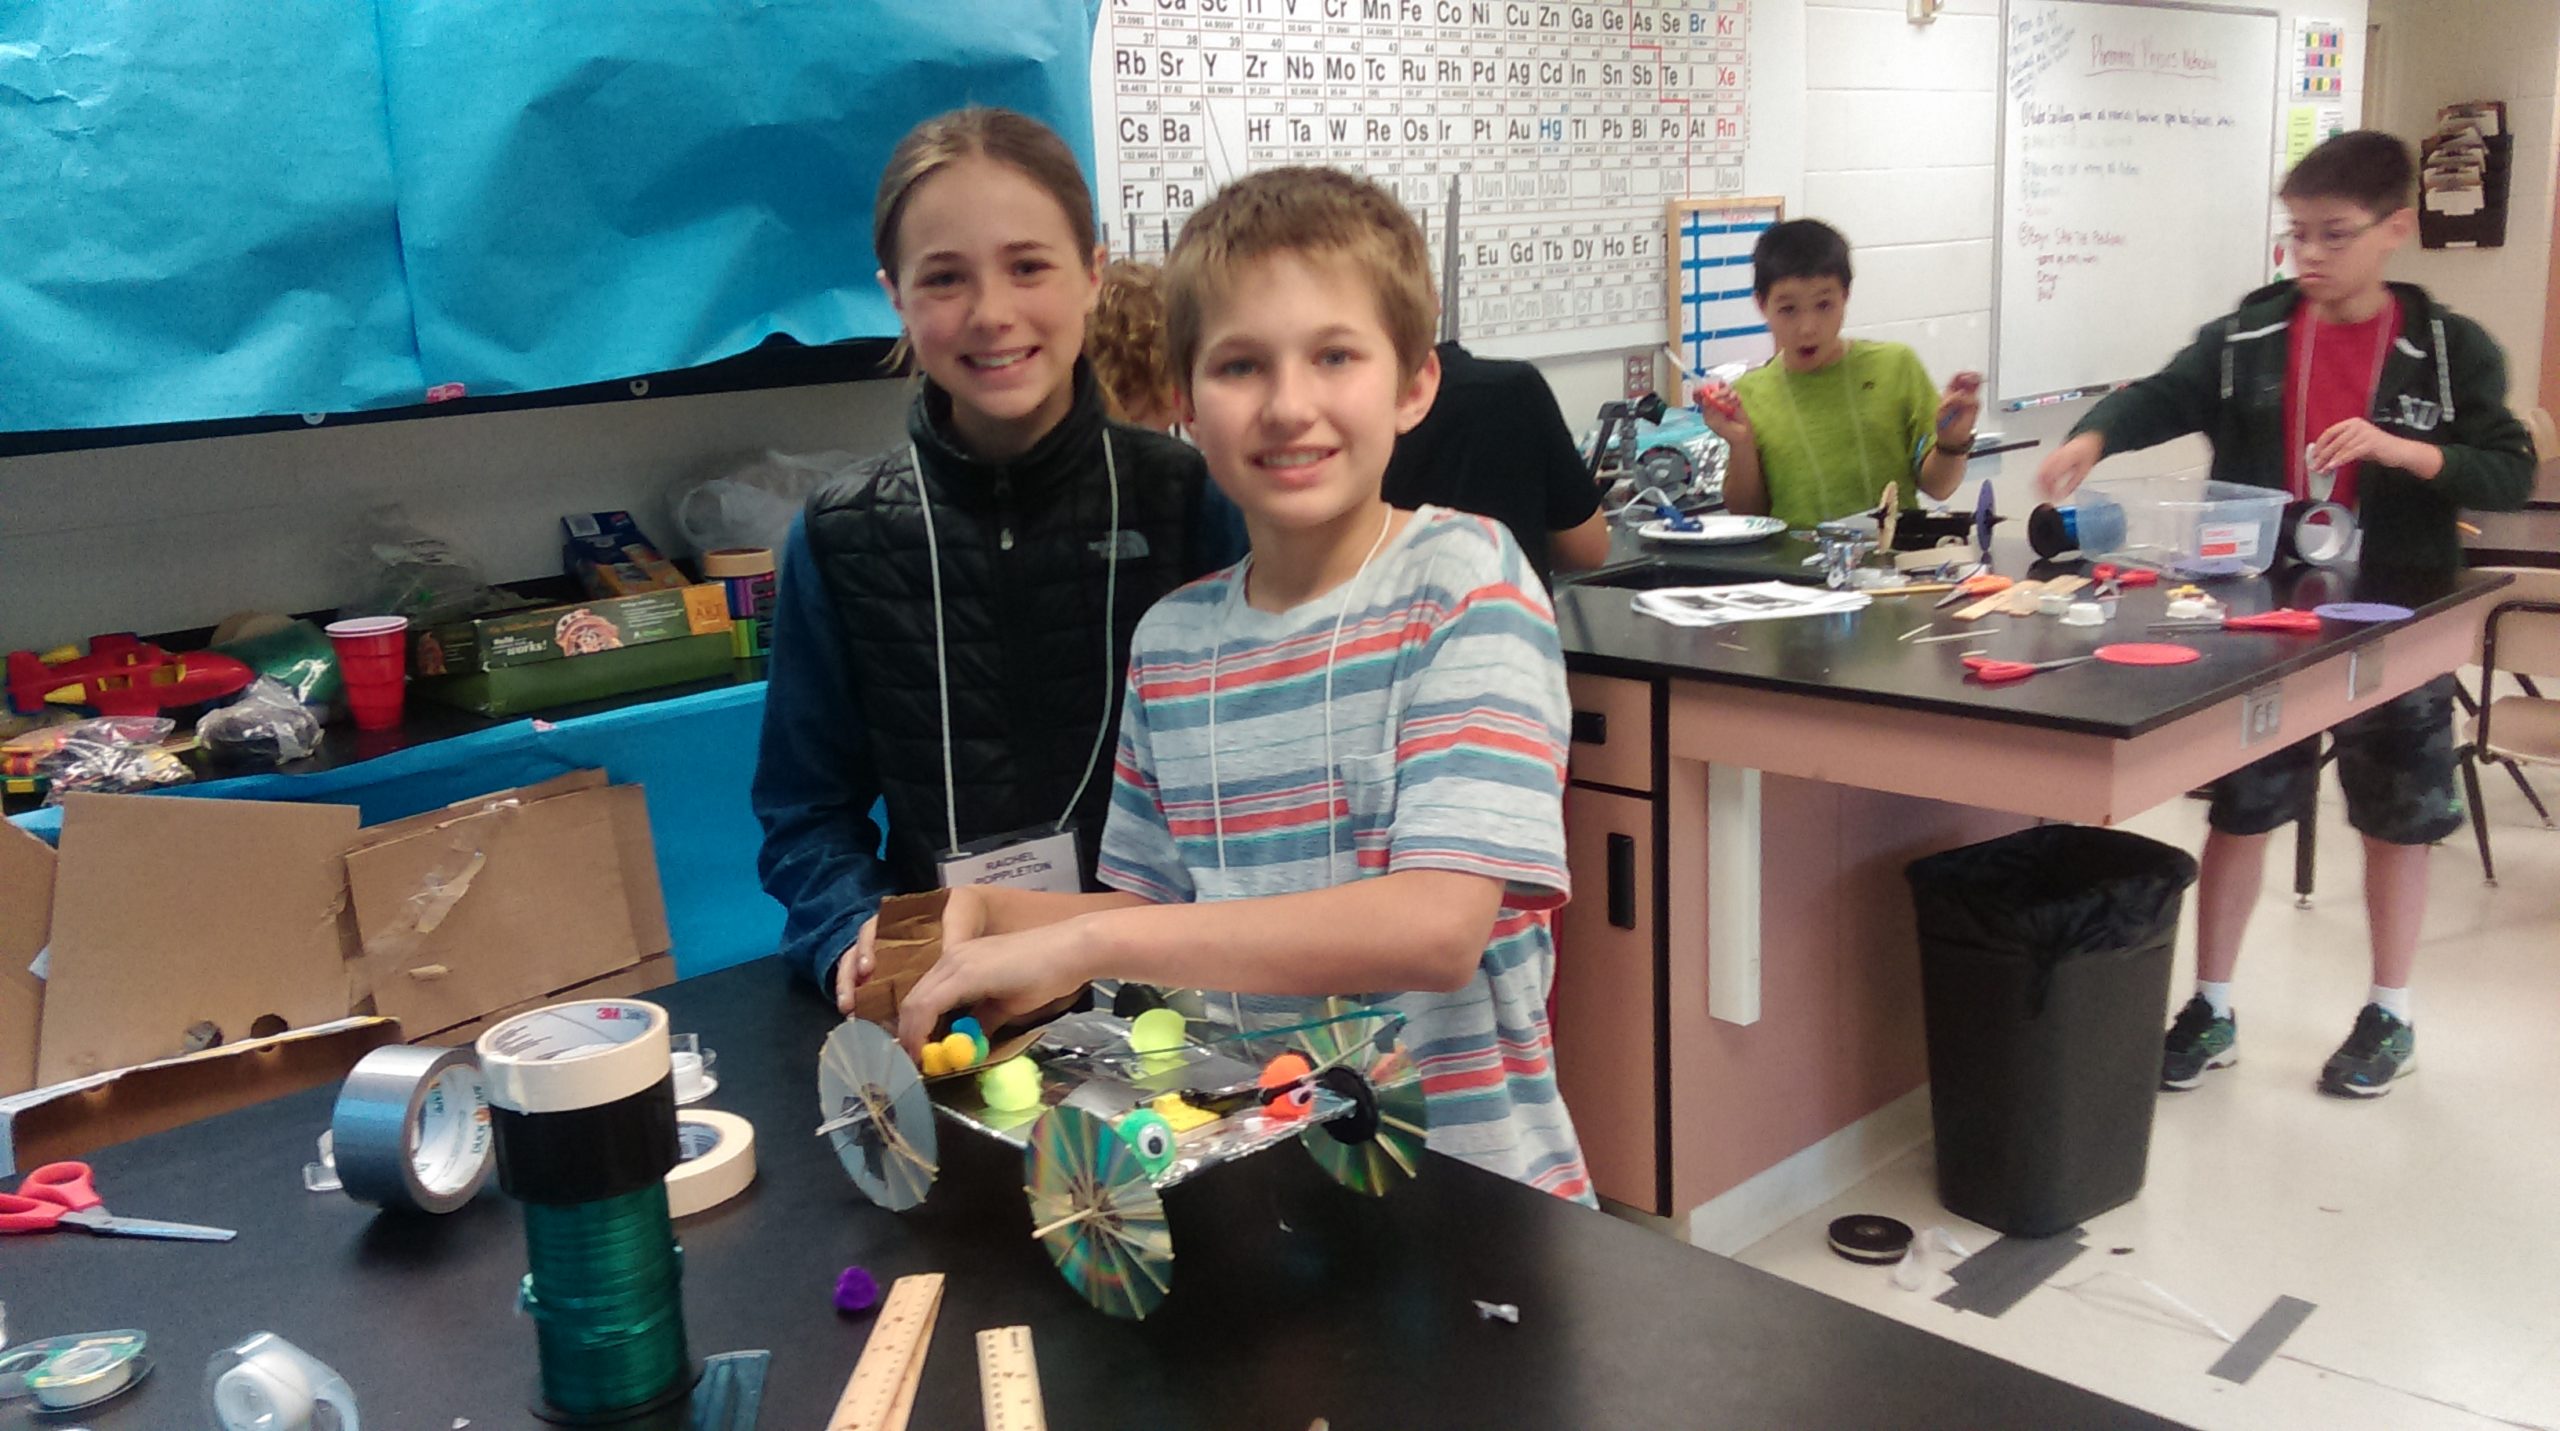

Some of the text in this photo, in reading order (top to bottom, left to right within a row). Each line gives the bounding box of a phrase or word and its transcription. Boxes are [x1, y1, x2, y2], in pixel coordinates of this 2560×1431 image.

[1325, 0, 1348, 18] Cr
[1363, 0, 1391, 20] Mn
[1401, 0, 1422, 21] Fe
[1437, 1, 1462, 24] Co
[1472, 2, 1490, 24] Ni
[1507, 4, 1529, 26] Cu
[1540, 6, 1560, 28] Zn
[1571, 7, 1593, 29] Ga
[1602, 9, 1624, 31] Ge
[1633, 11, 1652, 32] As
[1662, 12, 1681, 33] Se
[1689, 13, 1706, 33] Br
[1717, 15, 1734, 35] Kr
[1143, 33, 1154, 45] 37
[1186, 34, 1198, 46] 38
[1229, 36, 1241, 47] 39
[1271, 38, 1282, 49] 40
[1116, 50, 1146, 76] Rb
[1160, 51, 1184, 77] Sr
[1203, 53, 1217, 77] Y
[1245, 54, 1268, 79] Zr
[1286, 56, 1314, 80] Nb
[1326, 57, 1356, 81] Mo
[1364, 58, 1386, 81] Tc
[1402, 59, 1426, 82] Ru
[1438, 60, 1462, 82] Rh
[1473, 60, 1495, 83] Pd
[1507, 61, 1530, 85] Ag
[1540, 62, 1562, 84] Cd
[1571, 63, 1586, 84] In
[1602, 63, 1623, 85] Sn
[1632, 65, 1653, 85] Sb
[1662, 66, 1678, 86] Te
[1718, 66, 1736, 86] Xe
[1146, 99, 1158, 112] 55
[1189, 100, 1201, 112] 56
[1120, 117, 1149, 142] Cs
[1163, 118, 1190, 142] Ba
[1248, 119, 1271, 142] Hf
[1289, 119, 1311, 142] Ta
[1329, 119, 1347, 142] W
[1366, 119, 1391, 142] Re
[1403, 119, 1429, 142] Os
[1439, 119, 1452, 141] Ir
[1474, 119, 1491, 140] Pt
[1508, 118, 1530, 140] Au
[1540, 119, 1562, 141] Hg
[1602, 118, 1623, 139] Pb
[1632, 118, 1648, 138] Bi
[1661, 118, 1680, 138] Po
[1690, 119, 1706, 138] At
[1717, 118, 1736, 138] Rn
[1149, 166, 1161, 178] 87
[1122, 184, 1144, 209] Fr
[1166, 184, 1194, 208] Ra
[1477, 244, 1499, 266] Eu
[1510, 241, 1534, 264] Gd
[1543, 239, 1564, 261] Tb
[1573, 238, 1594, 260] Dy
[1603, 236, 1625, 257] Ho
[1633, 235, 1649, 255] Er
[986, 852, 1038, 870] RACHEL
[596, 1007, 621, 1020] 3M
